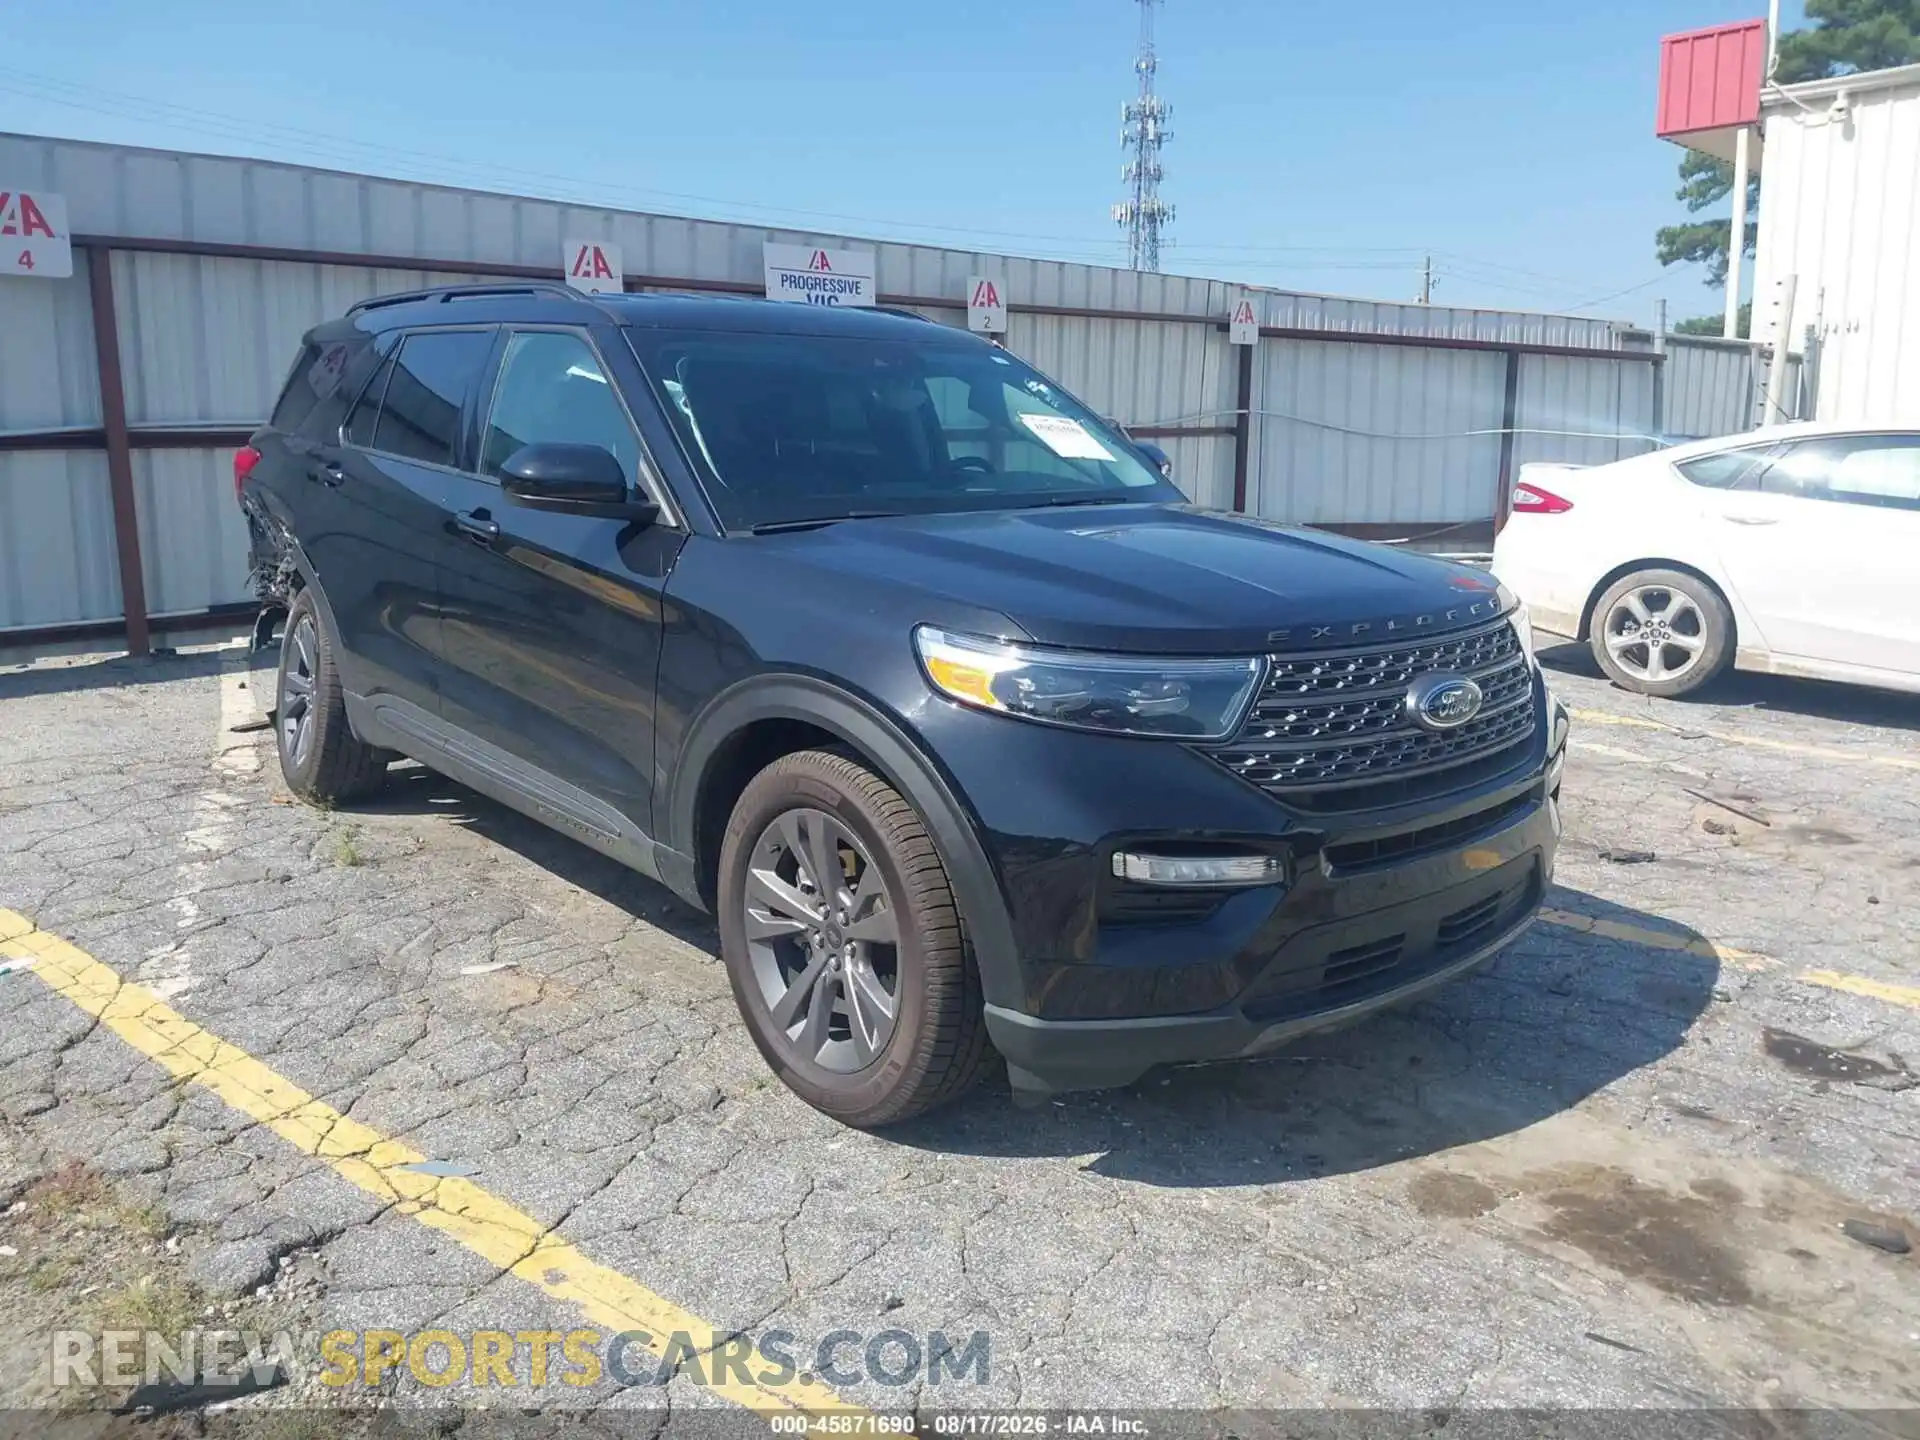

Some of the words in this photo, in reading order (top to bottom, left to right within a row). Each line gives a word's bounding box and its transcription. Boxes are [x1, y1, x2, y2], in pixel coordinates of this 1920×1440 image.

[18, 250, 35, 269] 4
[780, 274, 862, 295] PROGRESSIVE
[984, 315, 992, 329] 2
[1439, 690, 1473, 717] Ford
